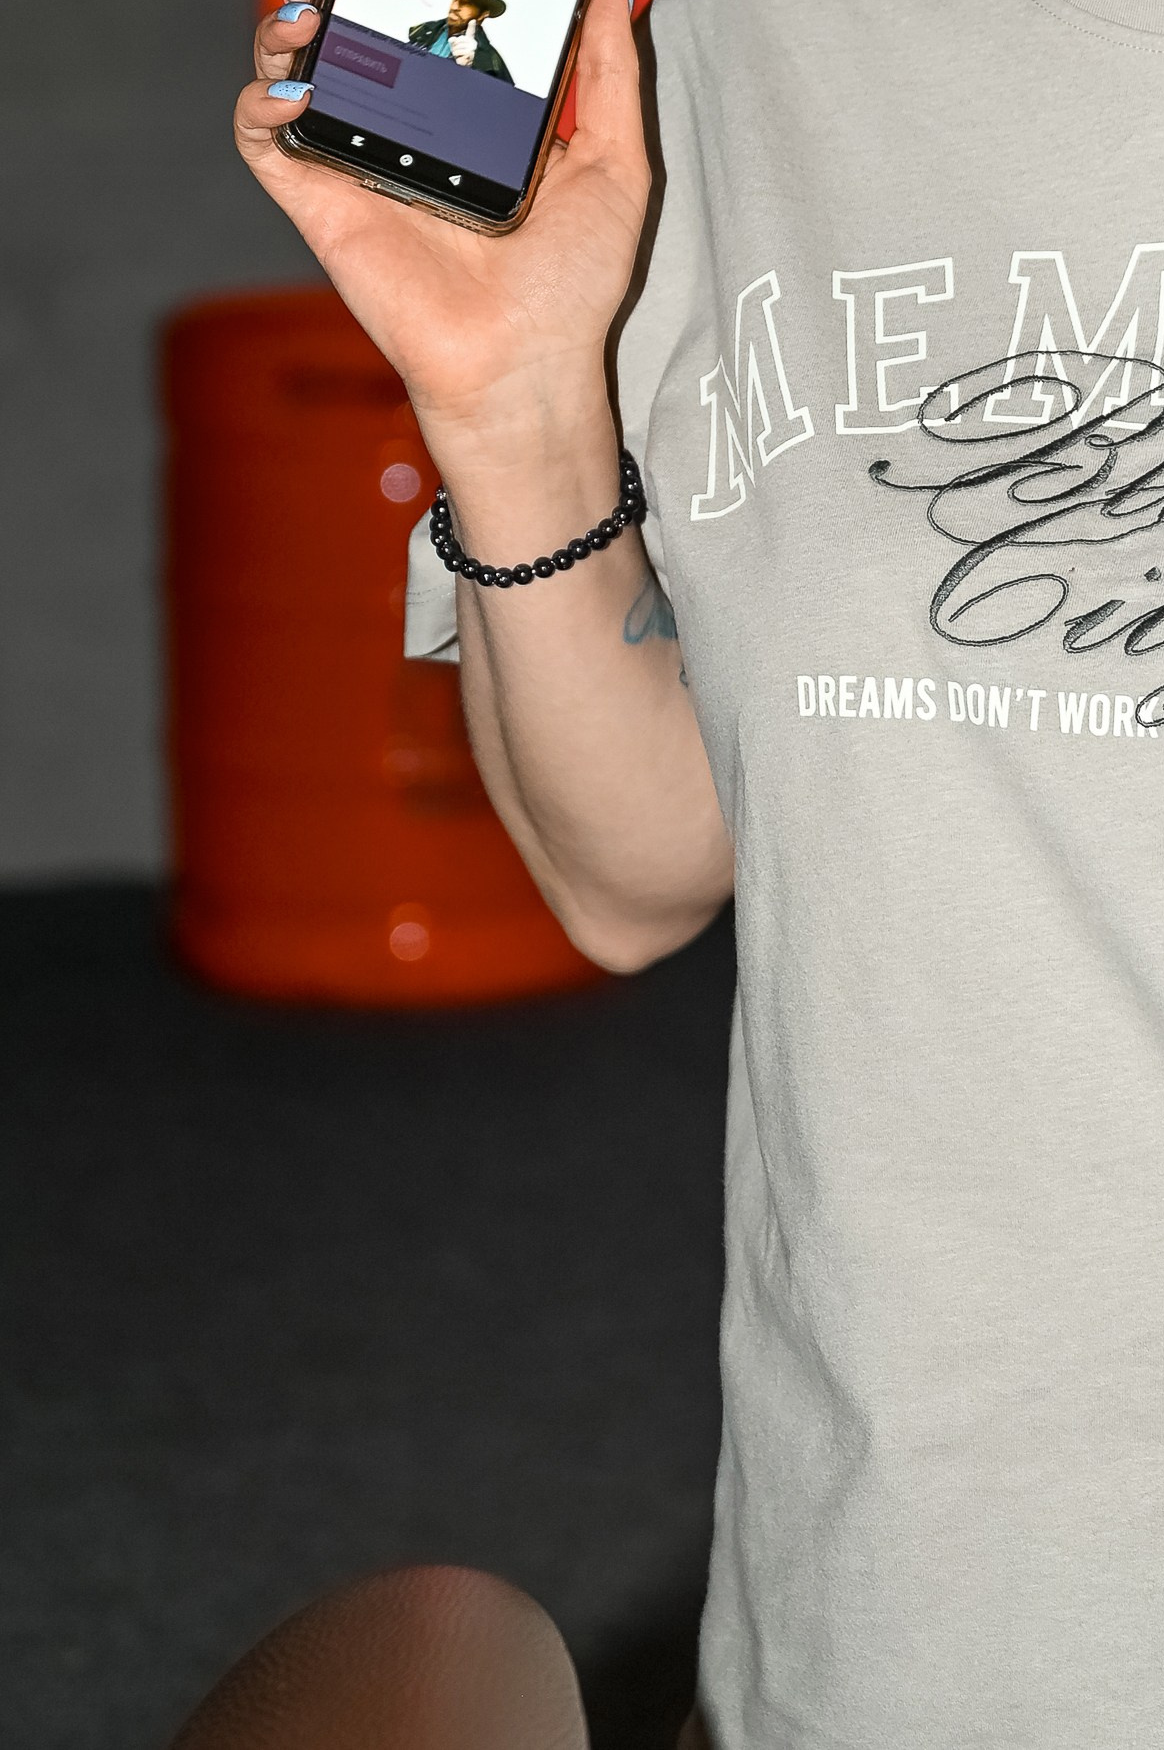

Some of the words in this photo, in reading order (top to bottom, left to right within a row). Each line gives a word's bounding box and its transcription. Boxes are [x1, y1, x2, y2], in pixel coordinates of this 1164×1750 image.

[334, 45, 388, 75] ОТПРАВИТЬ
[796, 673, 937, 720] DREAMS
[947, 681, 1048, 730] DON'T
[1056, 691, 1160, 739] WORK
